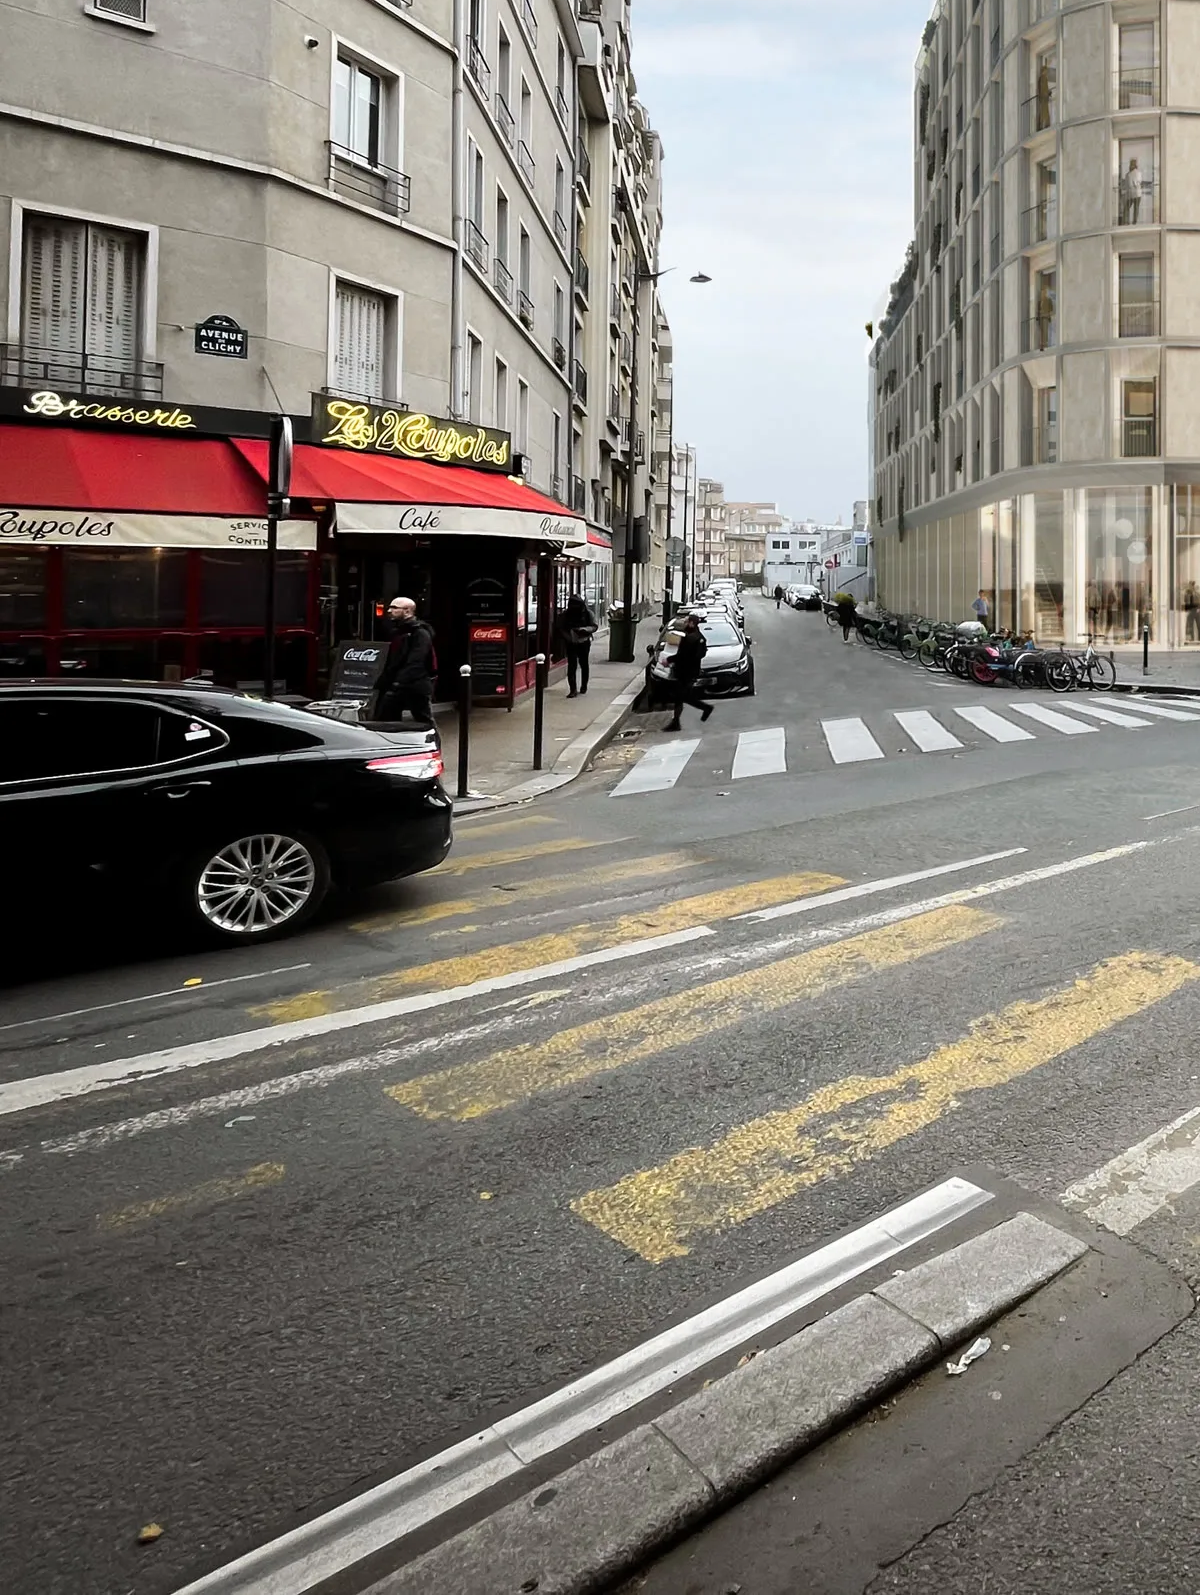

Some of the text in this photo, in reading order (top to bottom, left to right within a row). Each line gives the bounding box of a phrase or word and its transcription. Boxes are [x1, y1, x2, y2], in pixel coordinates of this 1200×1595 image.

[200, 329, 243, 342] AVENUE
[201, 341, 242, 353] CLICHY
[23, 391, 197, 428] Brasserie
[321, 400, 509, 465] Les 2 Coupoles
[230, 521, 269, 531] SERVIC
[399, 508, 441, 531] Café
[228, 535, 269, 546] CONTIN
